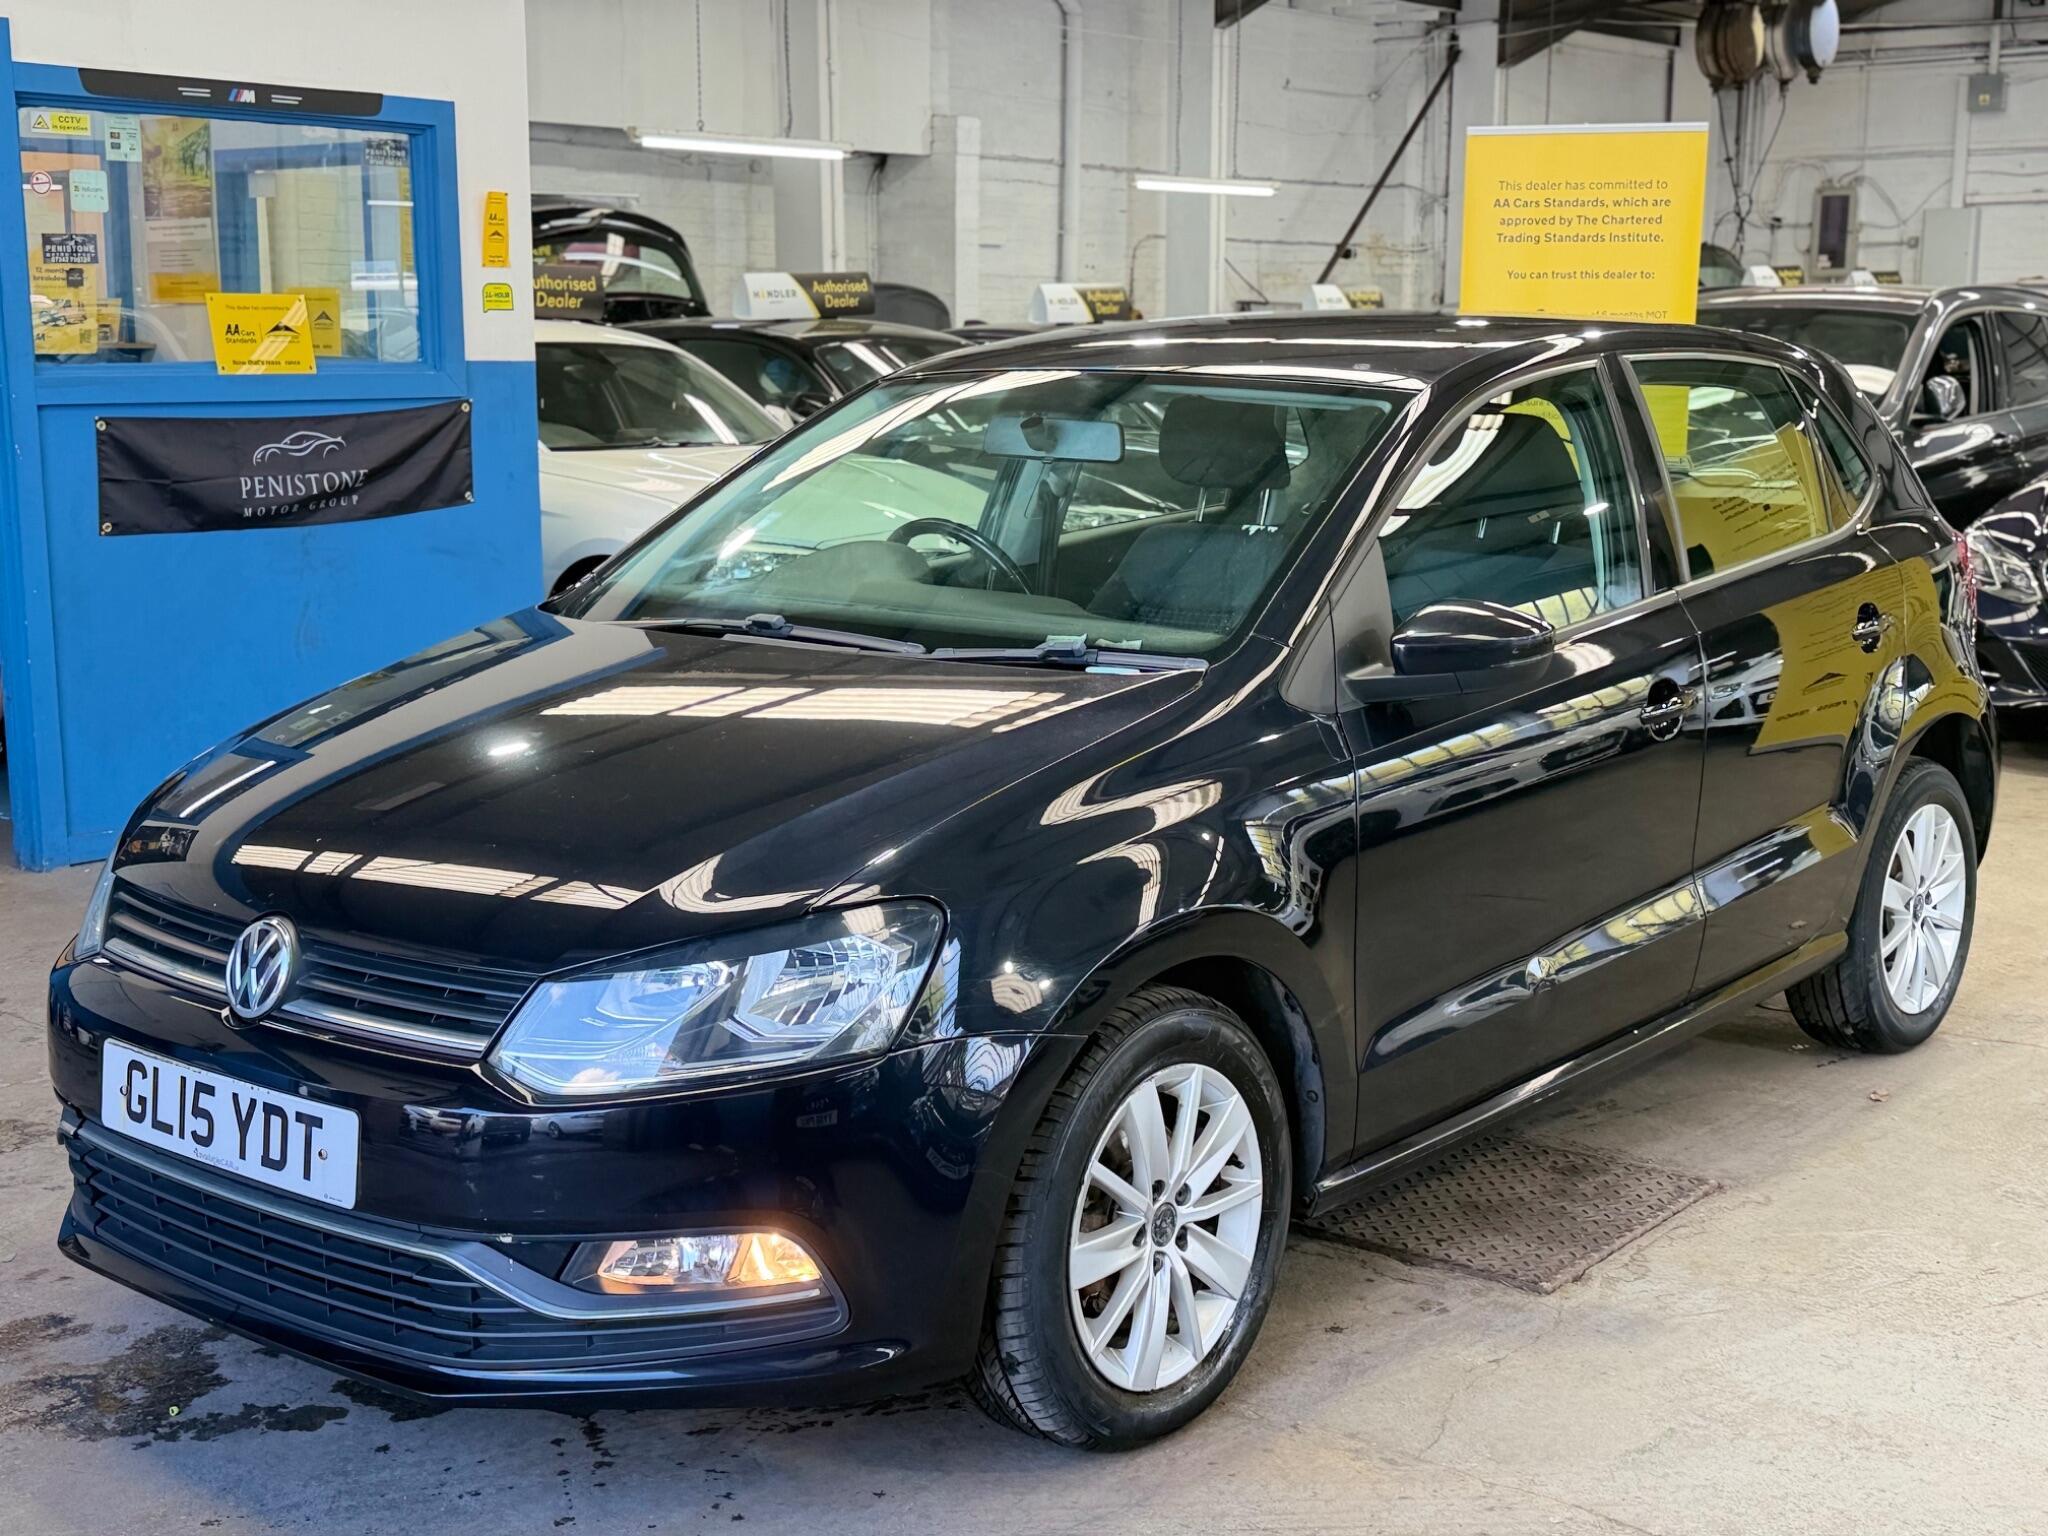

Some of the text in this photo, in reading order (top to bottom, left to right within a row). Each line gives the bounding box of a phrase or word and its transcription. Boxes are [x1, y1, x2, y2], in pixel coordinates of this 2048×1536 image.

[58, 115, 81, 123] CCTV
[1498, 180, 1668, 191] This dealer has committed to
[1493, 197, 1672, 209] AA Cars Standards, which are
[1499, 214, 1663, 227] approved by The Chartered
[1496, 232, 1664, 245] Trading Standards Institute.
[45, 244, 96, 253] PENISTONE
[1507, 270, 1655, 280] You can trust this dealer to:
[533, 274, 597, 292] uthorised
[812, 278, 868, 293] Authorised
[536, 290, 584, 308] Dealer
[824, 294, 860, 308] Dealer
[1646, 310, 1668, 319] MOT
[225, 323, 240, 336] AA
[239, 469, 369, 499] PENISTONE
[242, 494, 360, 518] MOTOR GROUP
[126, 1059, 323, 1181] GL15 YDT
